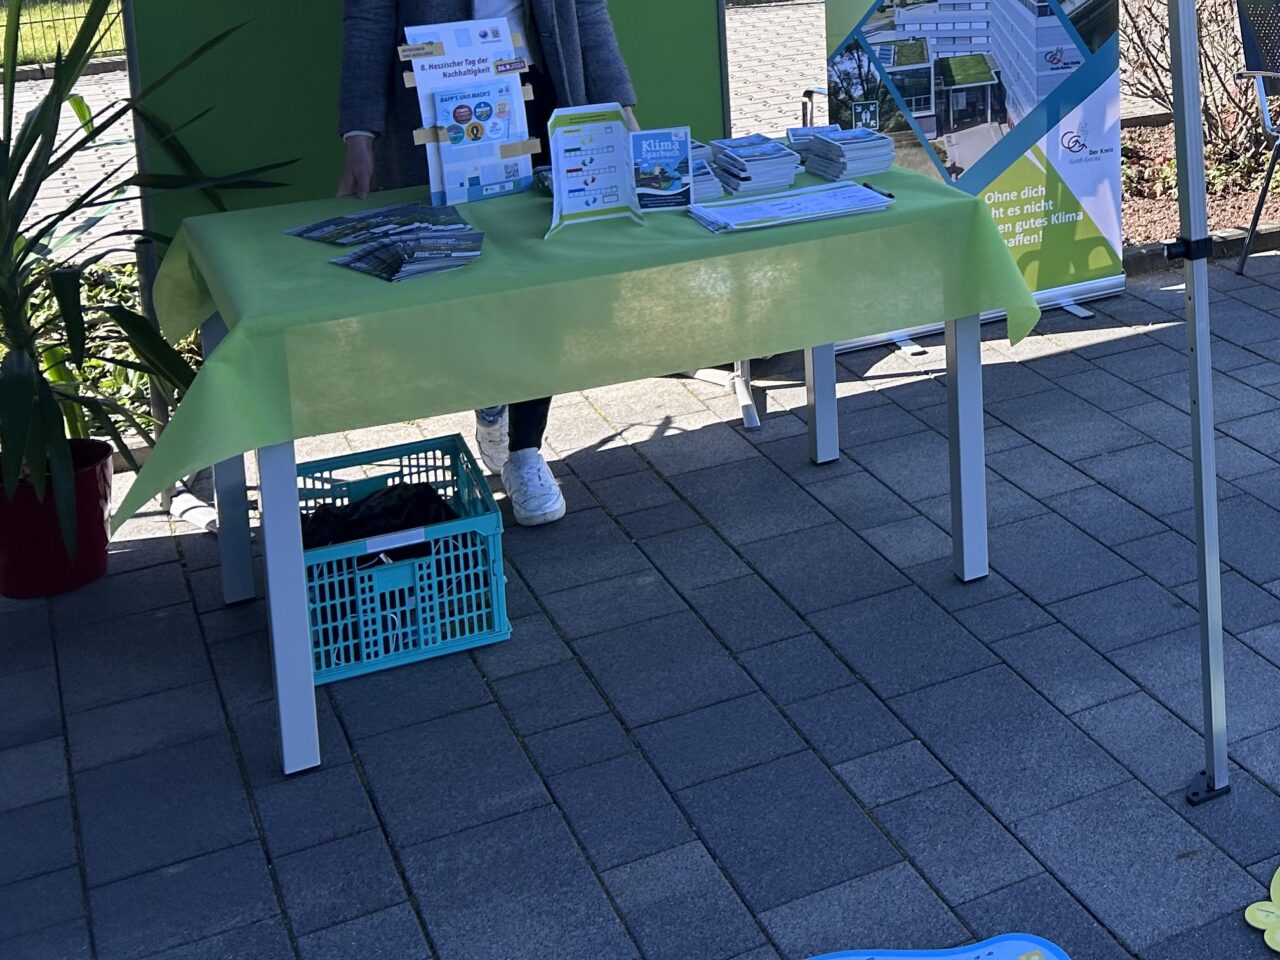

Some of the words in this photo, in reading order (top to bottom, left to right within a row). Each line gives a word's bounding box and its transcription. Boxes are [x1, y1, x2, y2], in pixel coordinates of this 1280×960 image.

[428, 60, 463, 70] Hessischer
[465, 59, 476, 68] Tag
[443, 66, 490, 78] Nachhaltigkeit
[641, 139, 680, 152] Klima
[984, 191, 1017, 204] Ohne
[1021, 184, 1046, 199] dich
[1007, 207, 1020, 217] es
[1023, 200, 1053, 214] nicht
[1015, 217, 1048, 233] gutes
[1051, 211, 1084, 225] Klima
